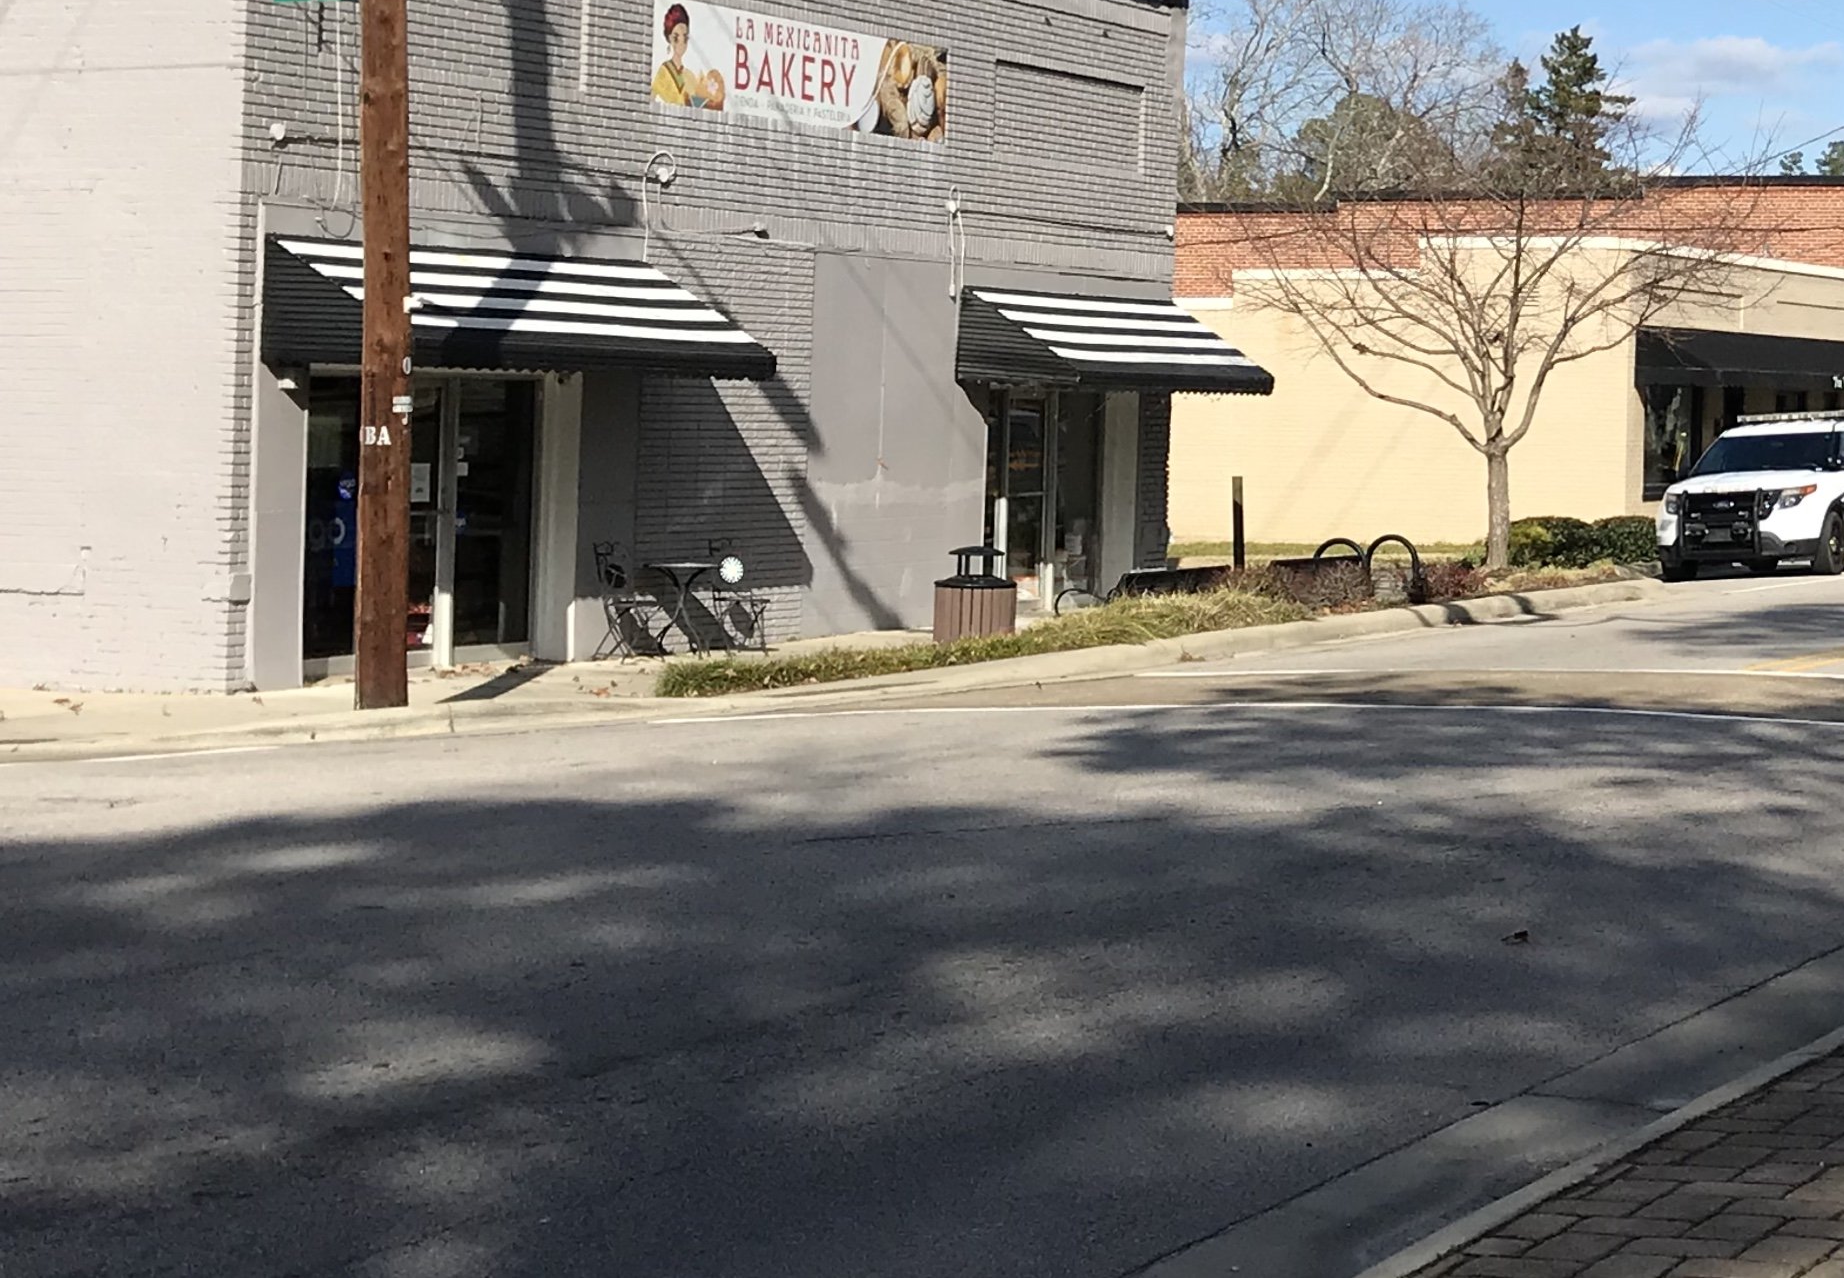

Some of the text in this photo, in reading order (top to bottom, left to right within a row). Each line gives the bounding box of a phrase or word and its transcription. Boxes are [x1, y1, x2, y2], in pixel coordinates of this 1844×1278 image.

[735, 16, 860, 61] LA MEXICANITA
[734, 42, 856, 108] BAKERY
